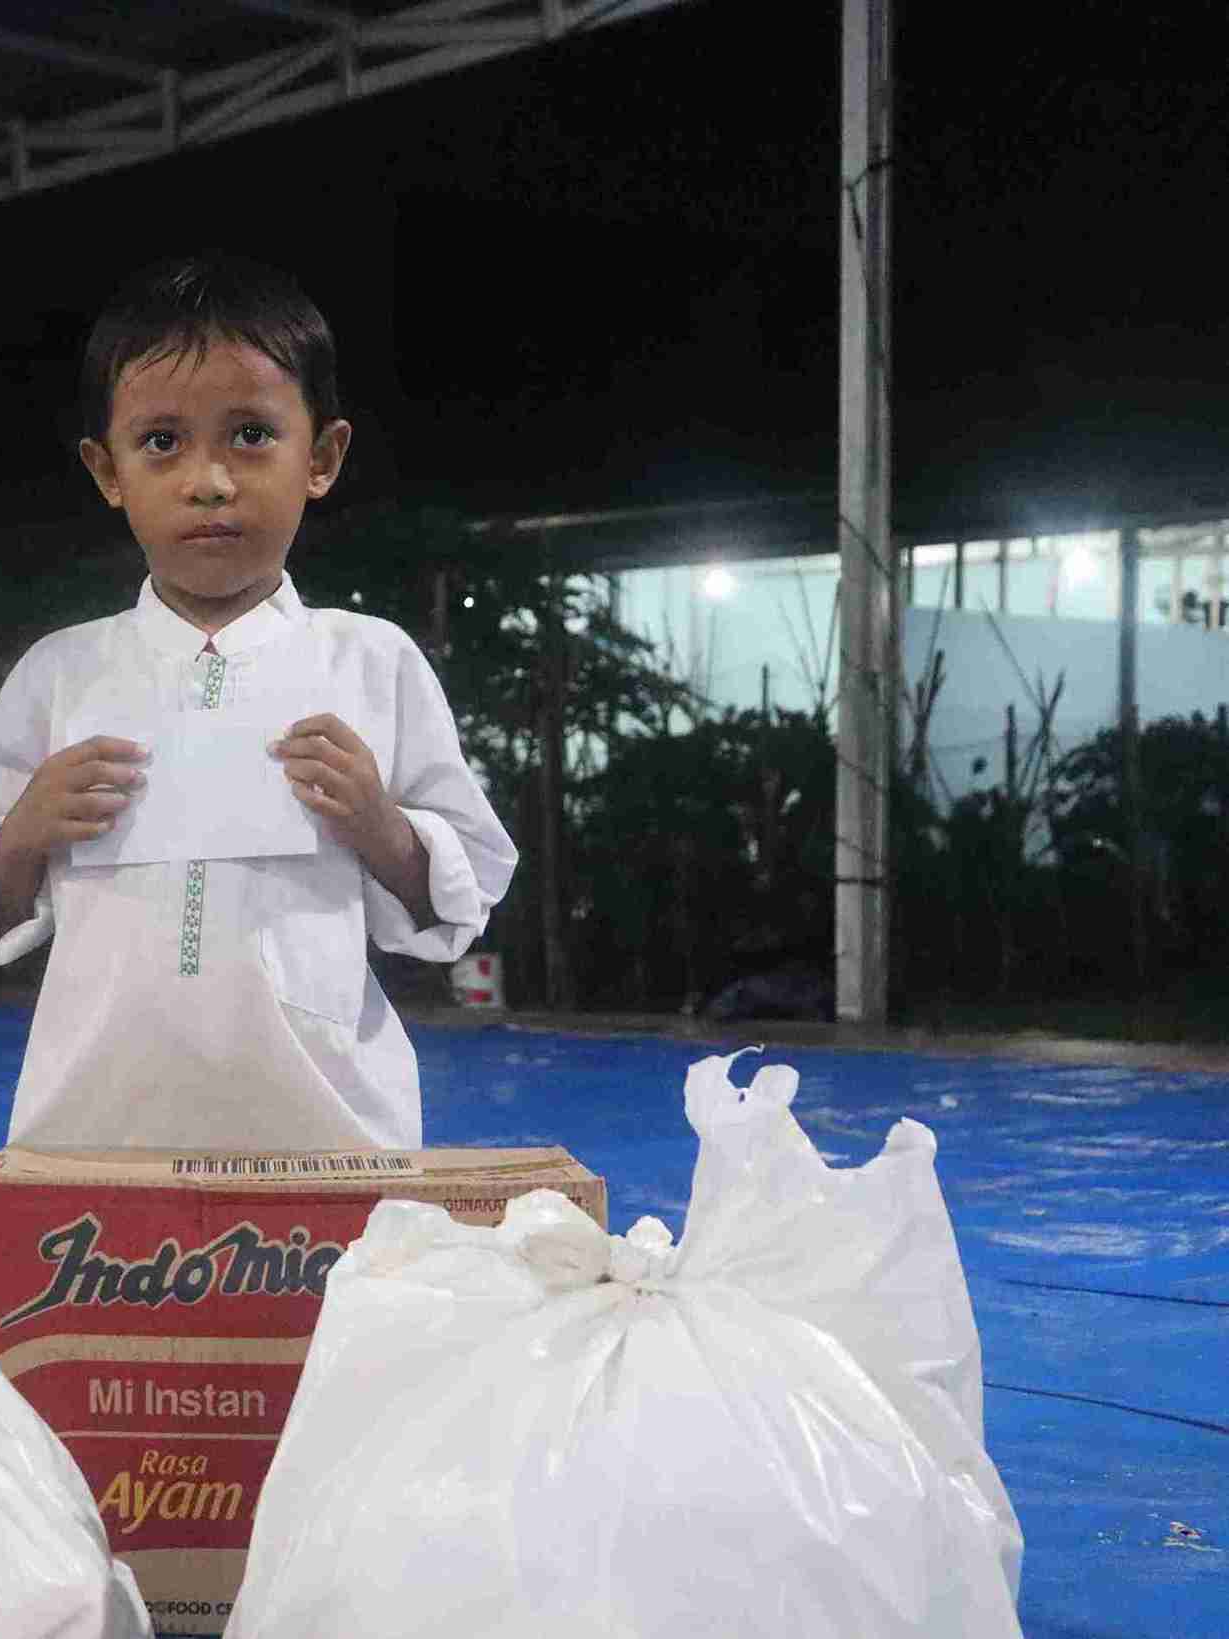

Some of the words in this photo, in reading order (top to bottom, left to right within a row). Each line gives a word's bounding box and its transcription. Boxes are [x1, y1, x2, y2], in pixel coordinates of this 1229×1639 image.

[89, 1379, 134, 1415] Mi
[145, 1380, 266, 1417] Instan
[139, 1449, 209, 1475] Rasa
[98, 1471, 243, 1534] Ayam
